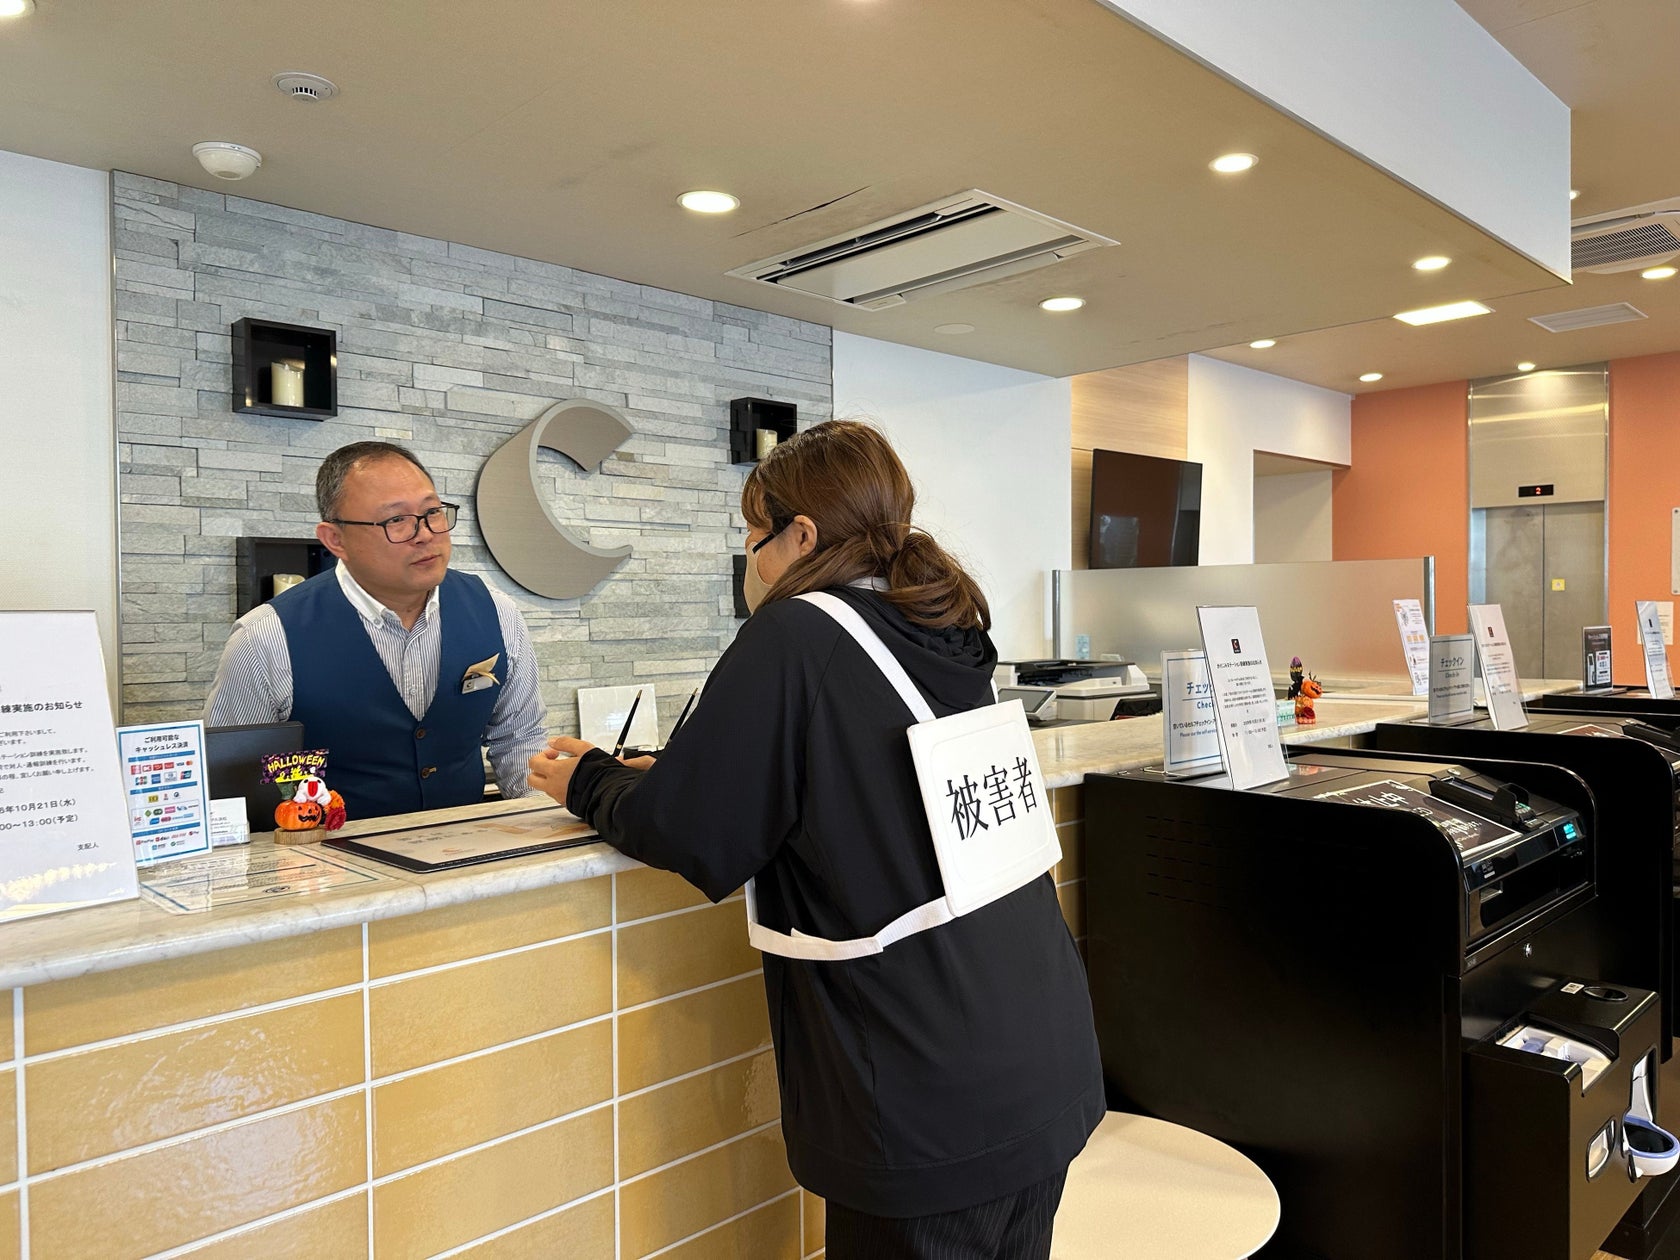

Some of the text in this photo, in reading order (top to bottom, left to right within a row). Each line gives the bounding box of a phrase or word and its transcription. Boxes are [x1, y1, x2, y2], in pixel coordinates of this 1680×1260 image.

[1186, 681, 1212, 695] チェッ
[144, 734, 180, 744] ご利用可能な
[135, 741, 189, 753] キャッシュレス決済
[267, 754, 325, 774] HALLOWEEN
[946, 756, 1038, 841] 被害者
[77, 842, 99, 851] 支配人
